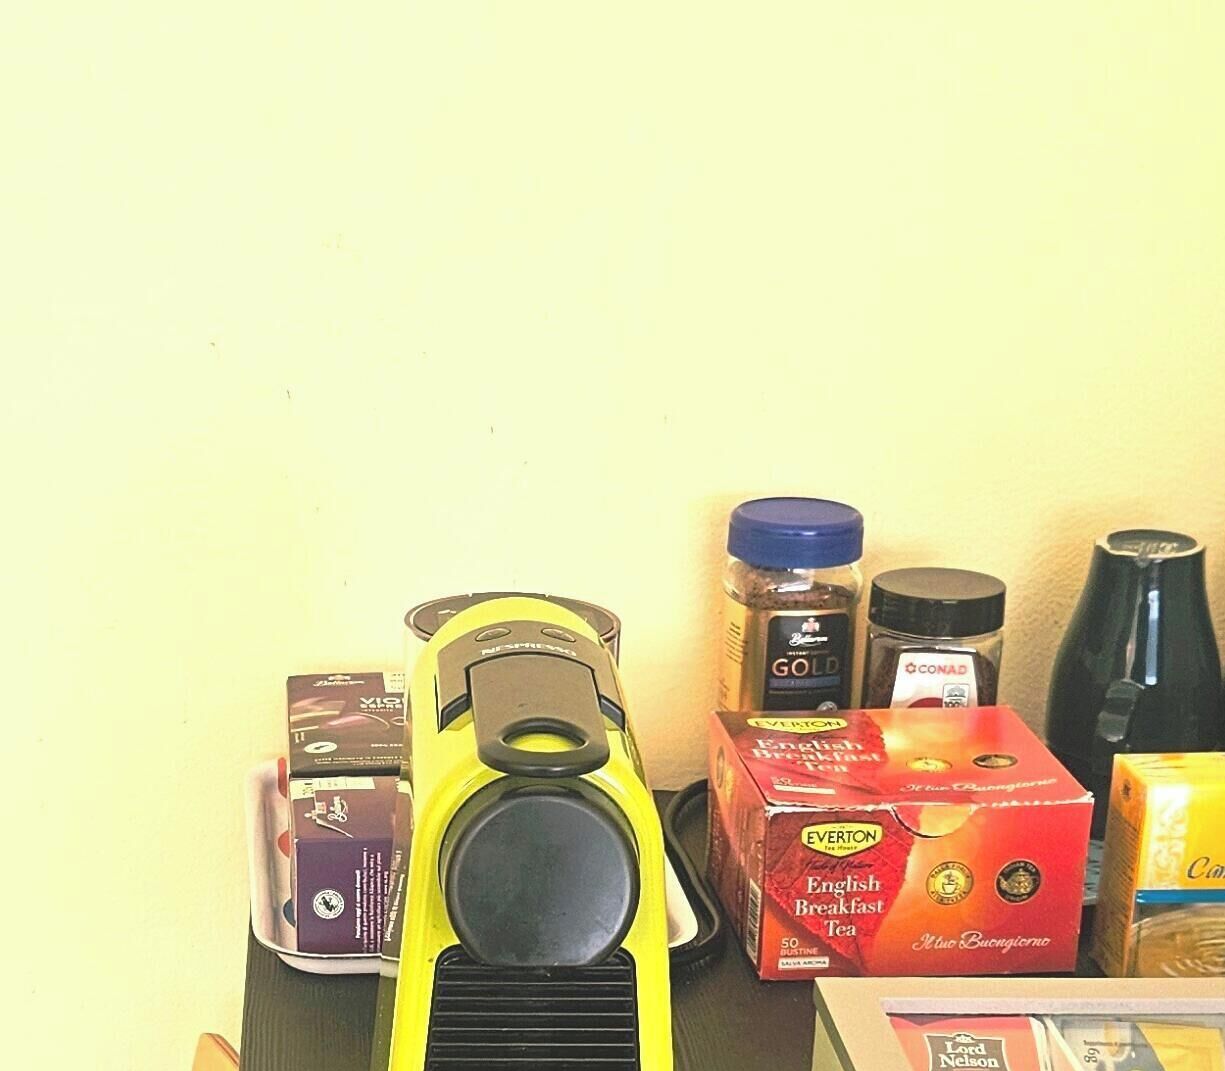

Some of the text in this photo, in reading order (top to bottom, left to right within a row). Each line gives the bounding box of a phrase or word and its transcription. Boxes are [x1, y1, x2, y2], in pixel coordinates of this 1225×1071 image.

[772, 657, 840, 677] GOLD
[918, 664, 968, 675] CONAD
[359, 697, 405, 706] VIO
[754, 719, 842, 728] EVERTON
[755, 738, 864, 753] English
[751, 748, 882, 763] Breakfast
[796, 761, 849, 773] Tea
[951, 777, 1059, 793] Buongiorno
[806, 829, 878, 845] EVERTON
[807, 874, 881, 898] English
[794, 896, 885, 917] Breakfast
[824, 919, 857, 937] Tea
[781, 937, 799, 949] 50
[912, 930, 1051, 954] Il tuo Buongiorno
[780, 946, 819, 957] BUSTINE
[944, 1041, 987, 1055] Lord
[938, 1053, 1000, 1068] Nelson
